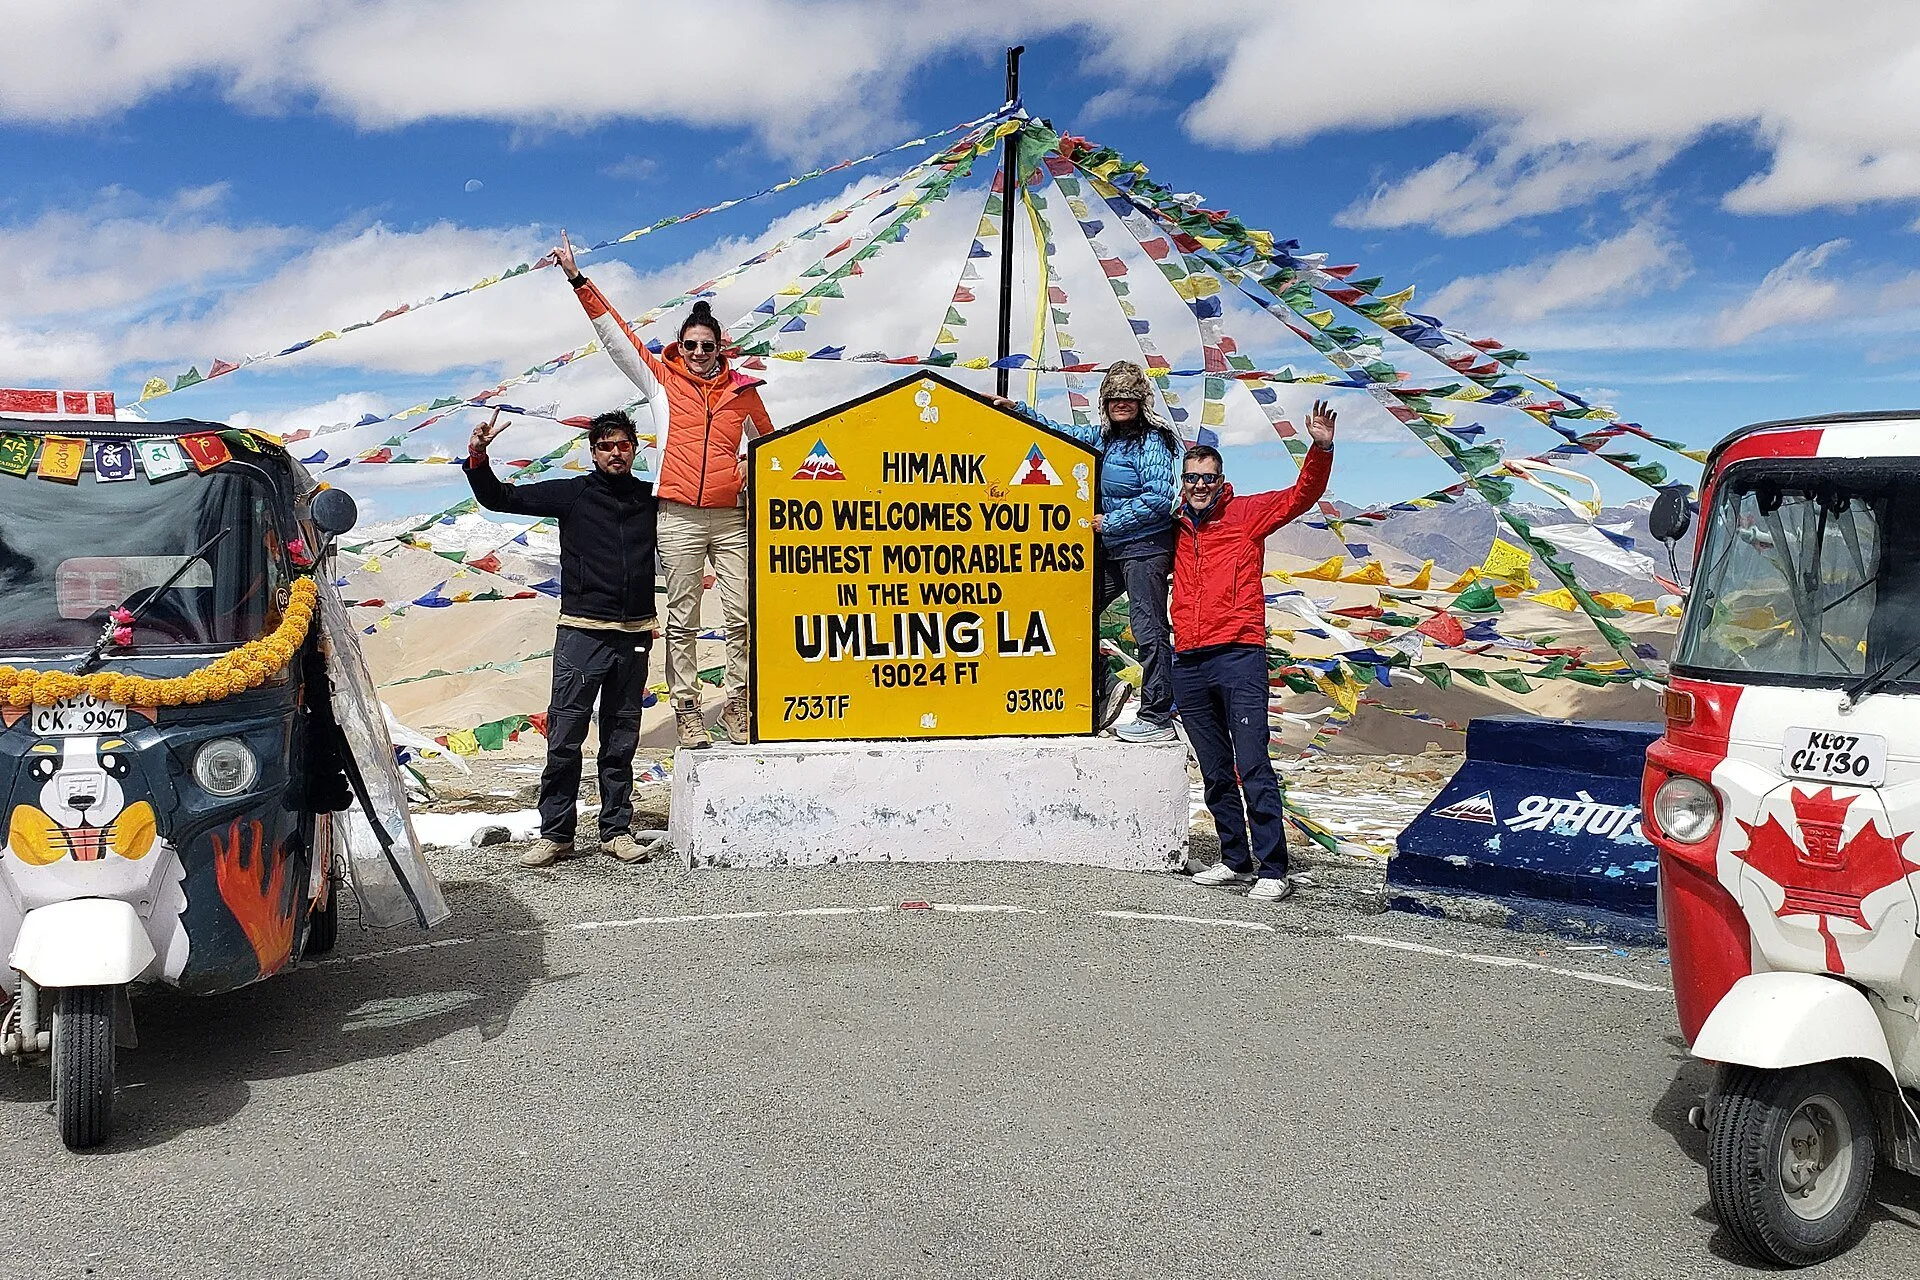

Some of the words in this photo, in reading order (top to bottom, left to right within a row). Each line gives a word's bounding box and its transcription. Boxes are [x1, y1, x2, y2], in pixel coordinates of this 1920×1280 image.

[883, 451, 986, 485] HIMANK
[769, 498, 823, 531] BRO
[832, 500, 973, 532] WELCOMES
[980, 502, 1030, 533] YOU
[1038, 503, 1071, 532] TO
[769, 544, 873, 575] HIGHEST
[883, 542, 1023, 576] MOTORABLE
[1029, 542, 1085, 573] PASS
[837, 583, 858, 607] IN
[867, 583, 910, 606] THE
[919, 582, 1003, 606] WORLD
[794, 610, 984, 662] UMLING
[996, 610, 1056, 657] LA
[871, 663, 947, 688] 19024
[954, 662, 980, 685] FT
[83, 709, 125, 732] 9967
[783, 694, 850, 722] 753TF
[1006, 687, 1064, 713] 93RCC
